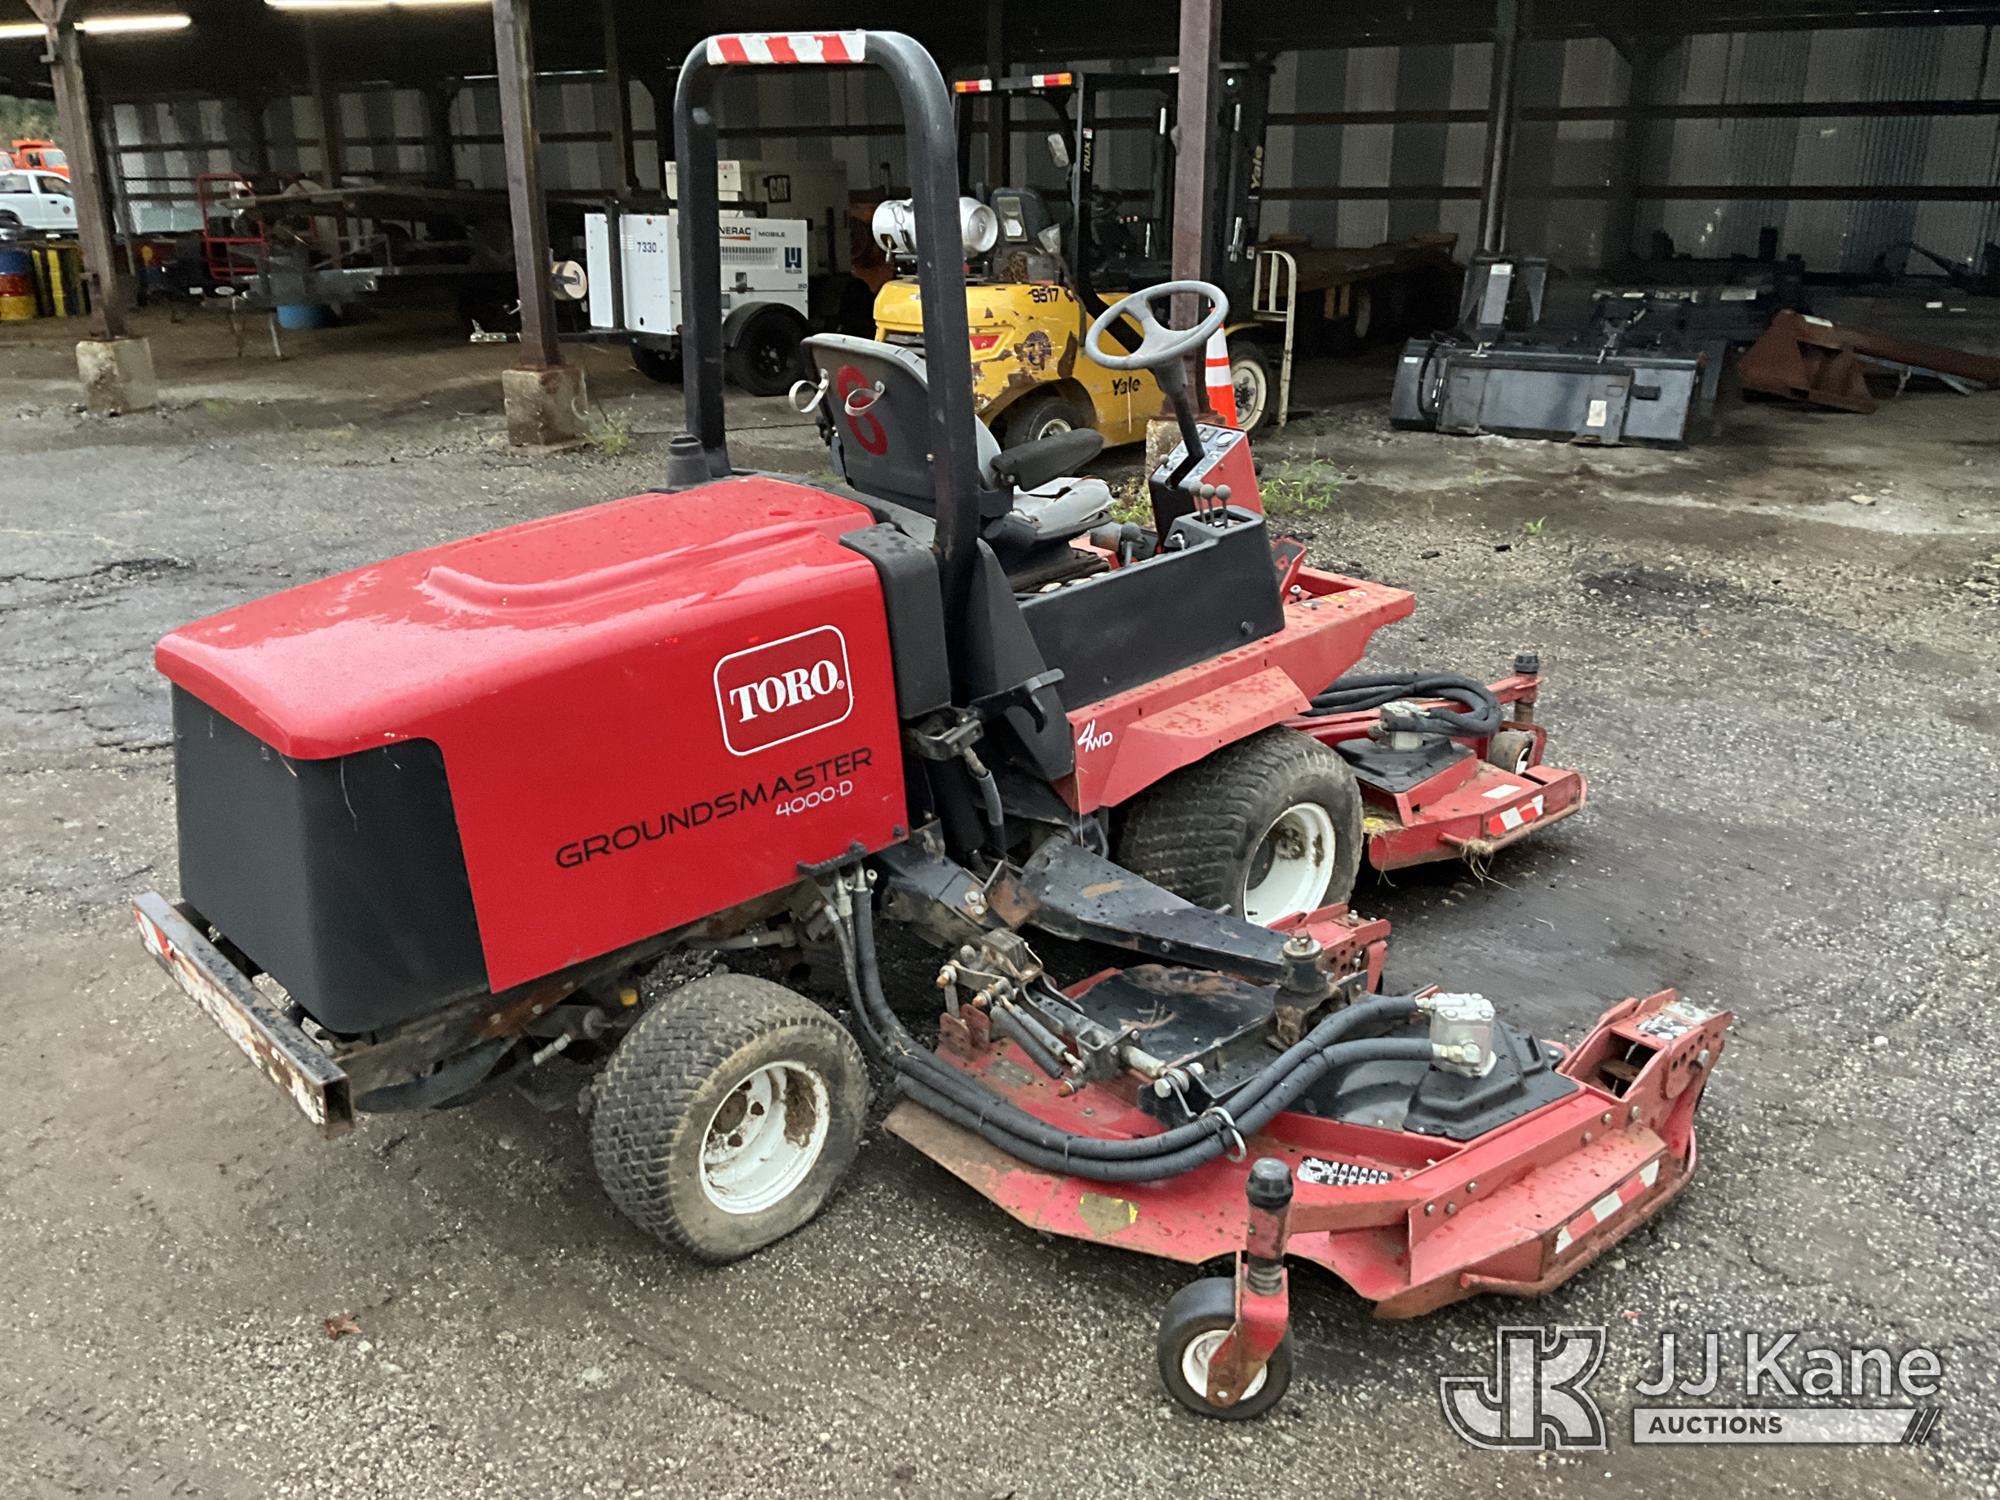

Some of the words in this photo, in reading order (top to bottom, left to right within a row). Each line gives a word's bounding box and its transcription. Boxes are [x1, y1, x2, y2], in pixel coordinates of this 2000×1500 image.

[1250, 145, 1263, 189] Yale
[719, 227, 751, 235] NERAC
[637, 241, 657, 253] 7330
[1031, 288, 1060, 303] 9517
[1112, 376, 1141, 396] Yale
[1077, 719, 1113, 753] 4WD
[555, 746, 873, 869] GROUNDSMASTER
